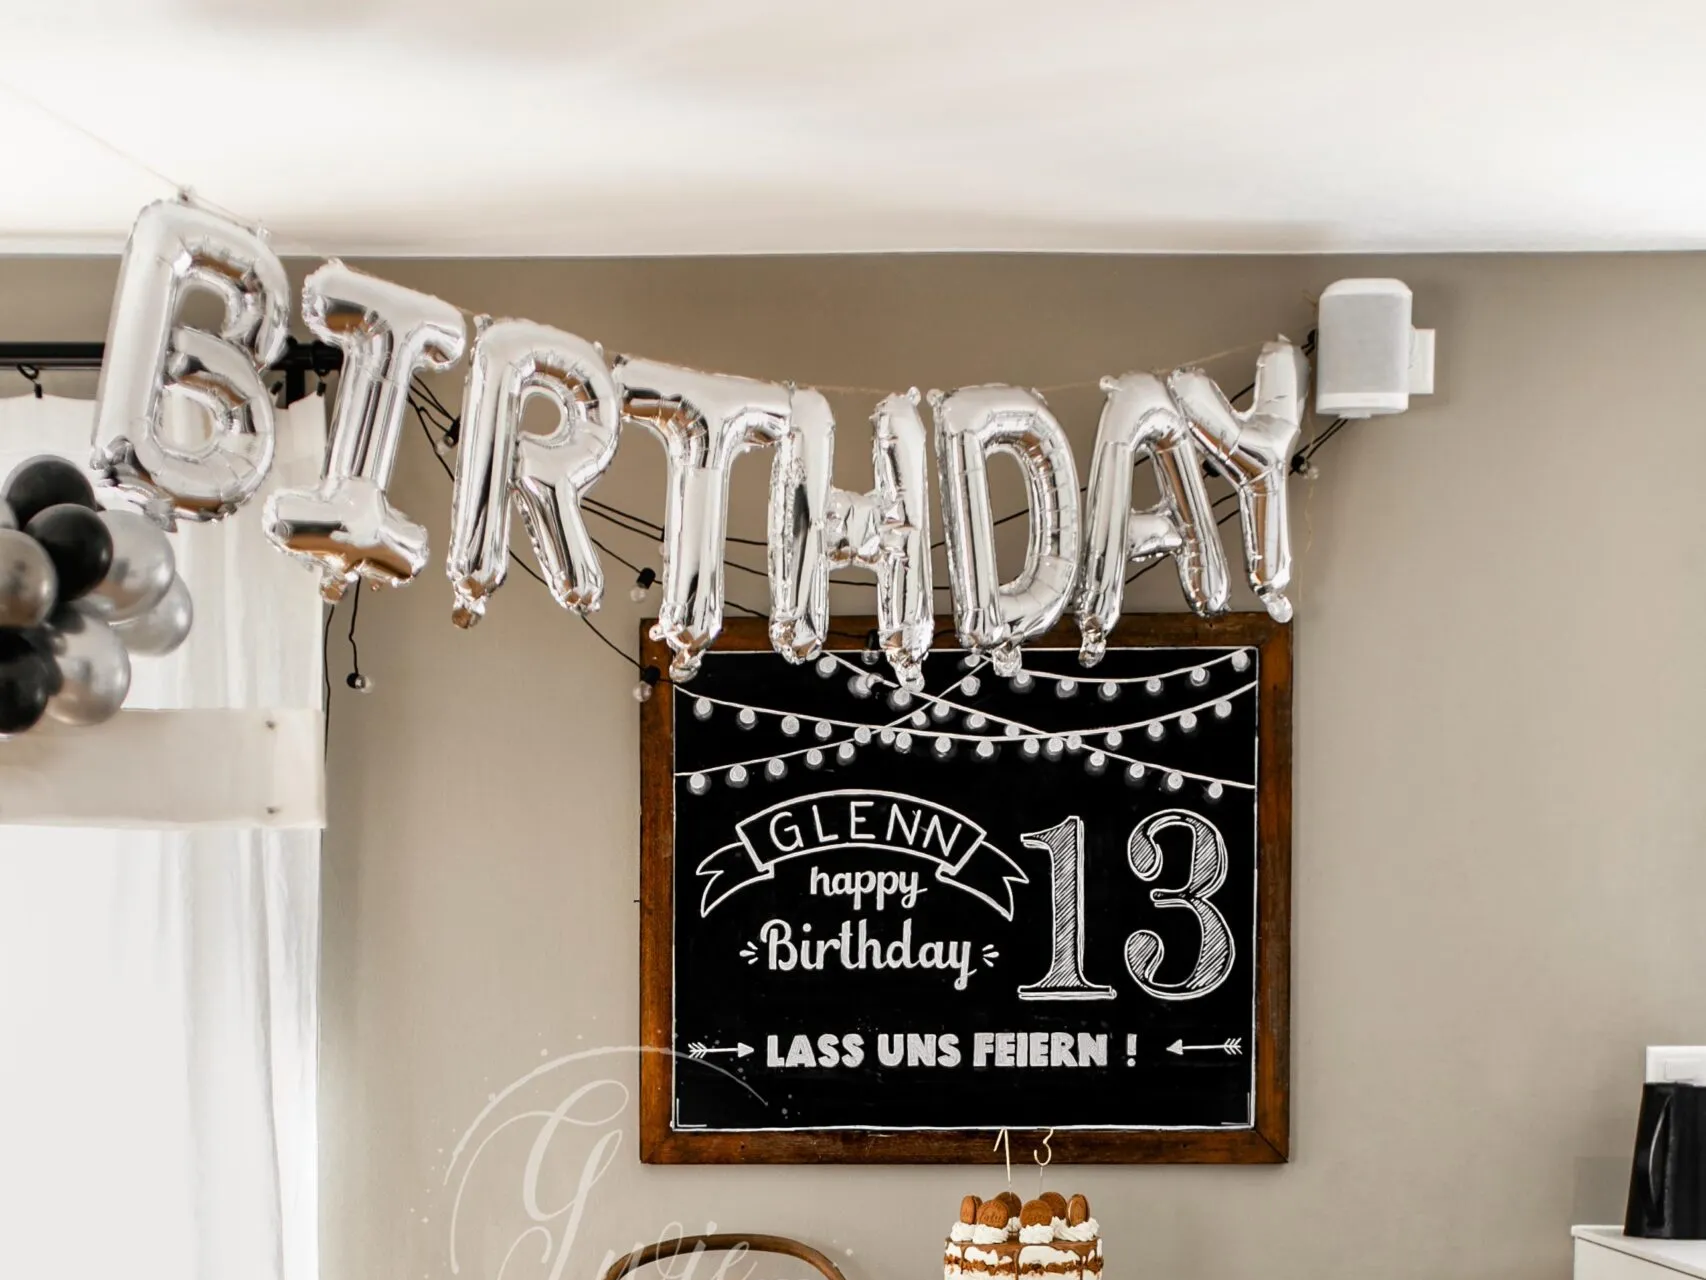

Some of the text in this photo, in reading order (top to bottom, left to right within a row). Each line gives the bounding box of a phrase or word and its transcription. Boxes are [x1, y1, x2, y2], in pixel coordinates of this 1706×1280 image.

[92, 198, 1306, 690] BIRTHDAY
[769, 801, 962, 857] GLENN
[809, 865, 927, 910] happy
[1018, 808, 1236, 1000] 13
[760, 918, 977, 989] Birthday
[766, 1033, 865, 1067] LASS
[877, 1033, 961, 1067] UNS
[973, 1033, 1108, 1068] FEIERN
